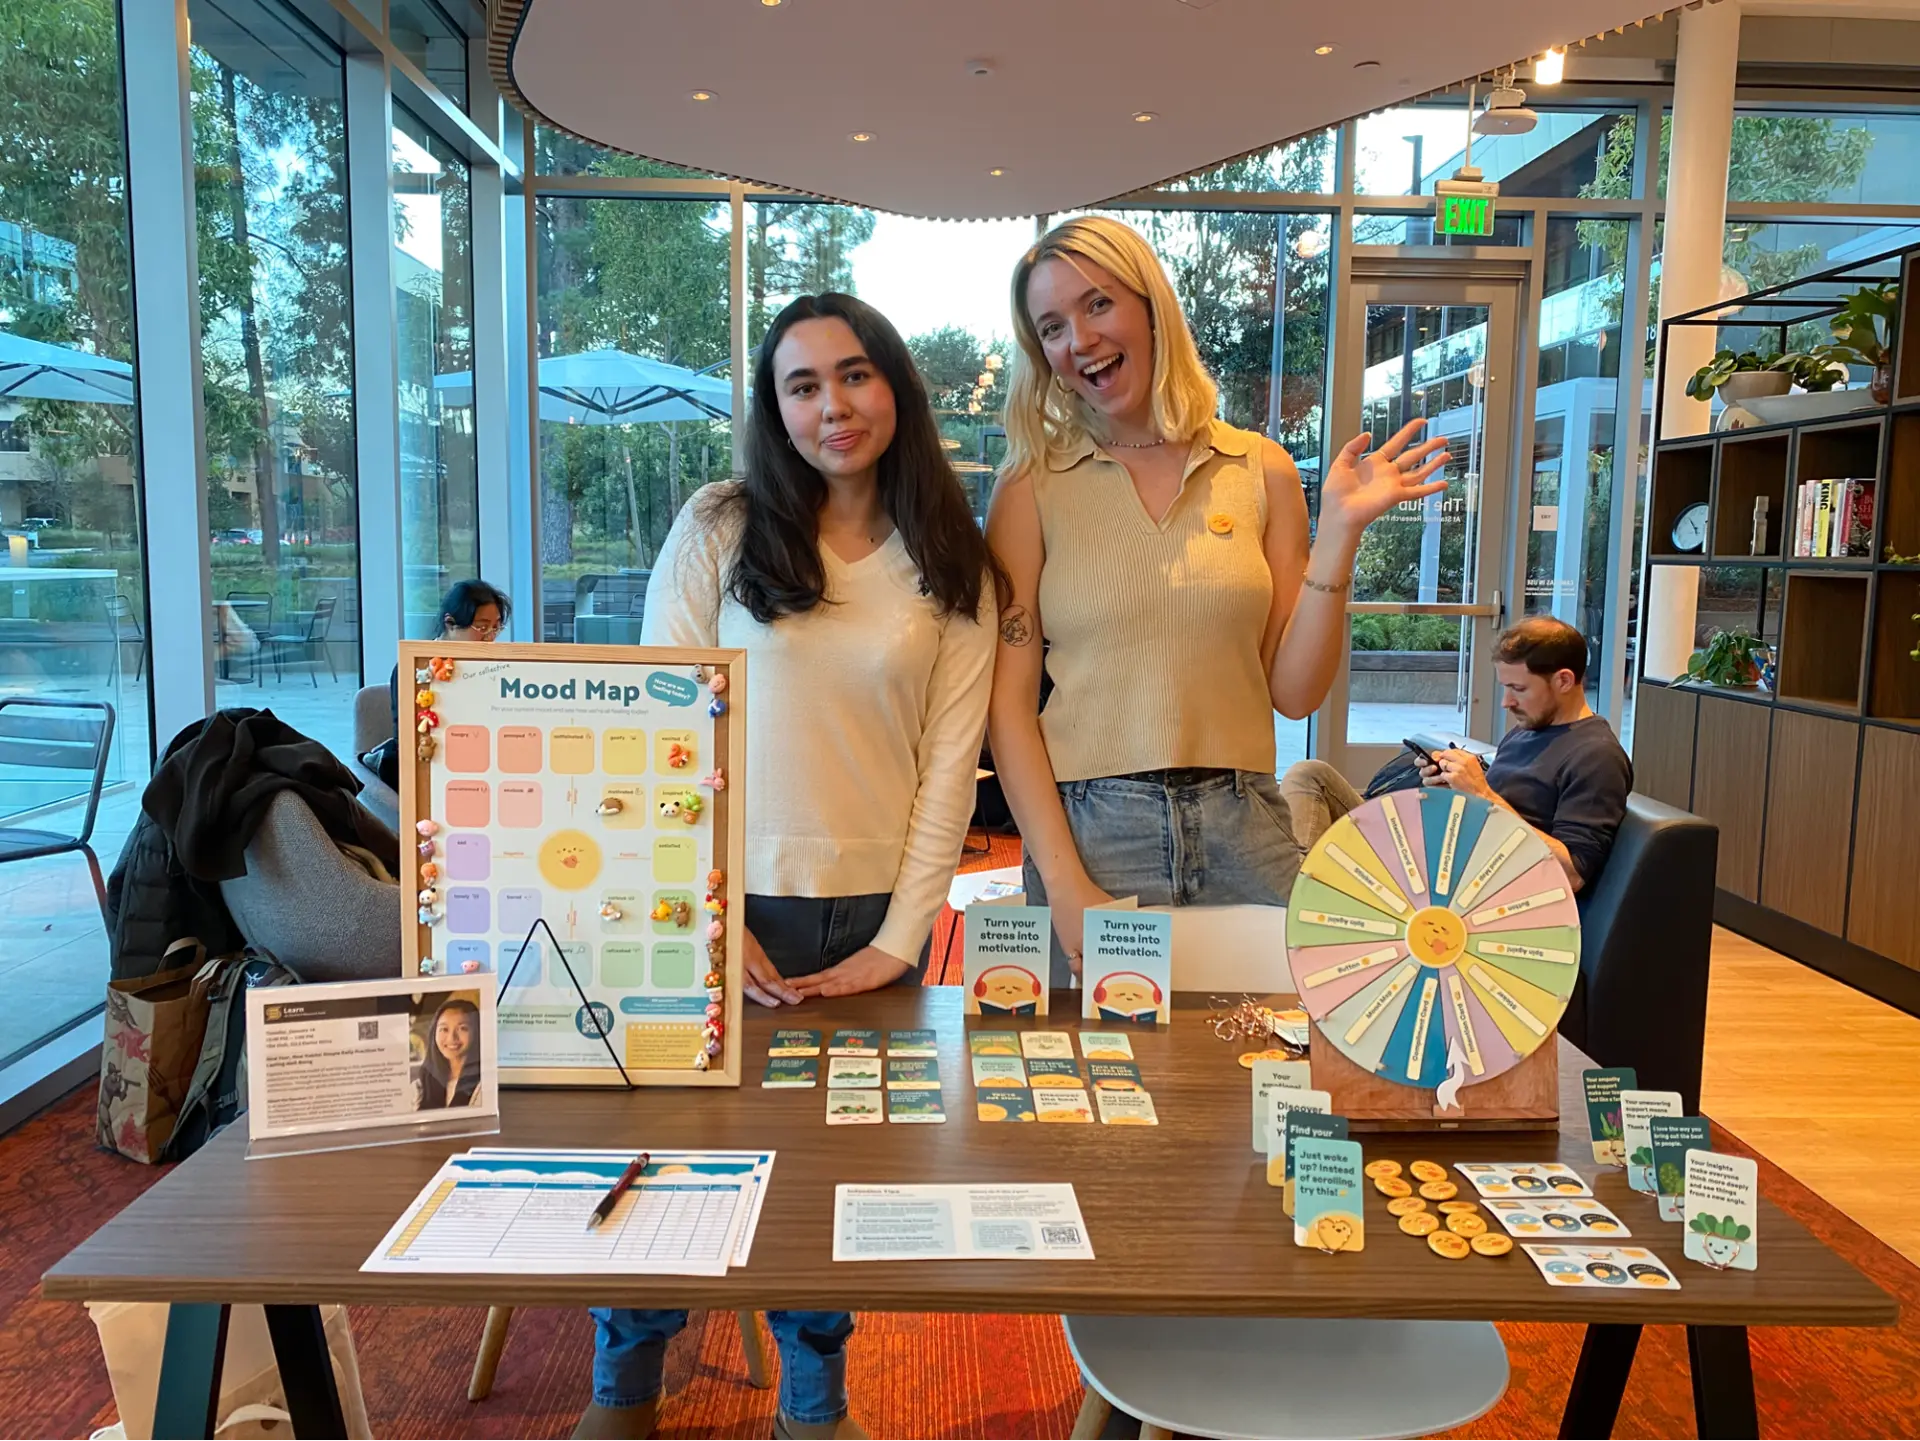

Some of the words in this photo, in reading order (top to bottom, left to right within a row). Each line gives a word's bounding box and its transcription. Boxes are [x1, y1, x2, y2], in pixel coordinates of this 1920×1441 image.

[1444, 197, 1489, 235] EXIT
[1820, 482, 1831, 511] KING
[462, 671, 477, 680] Our
[478, 663, 512, 677] collective
[654, 677, 667, 686] How
[500, 677, 576, 700] Mood
[585, 679, 640, 707] Map
[1446, 812, 1460, 855] Compliment
[1390, 817, 1405, 849] Intention
[1401, 848, 1412, 866] Card
[1442, 855, 1451, 873] Card
[1490, 853, 1505, 870] Mood
[1354, 867, 1375, 887] Sticker
[1479, 868, 1492, 881] Map
[1507, 900, 1531, 911] Button
[983, 917, 1009, 928] Turn
[1011, 920, 1037, 930] your
[1103, 919, 1130, 930] Turn
[1132, 923, 1158, 933] your
[1350, 920, 1365, 928] Spin
[980, 931, 1015, 940] stress
[1017, 931, 1040, 941] into
[1100, 933, 1136, 943] stress
[1138, 933, 1160, 945] into
[978, 943, 1041, 954] motivation.
[1098, 945, 1162, 958] motivation.
[1529, 949, 1544, 957] Spin
[1337, 962, 1361, 973] Button
[1365, 1002, 1381, 1019] Mood
[1380, 990, 1392, 1004] Map
[1496, 991, 1518, 1011] Sticker
[1457, 1003, 1466, 1021] Card
[1412, 1018, 1425, 1061] Compliment
[1420, 1000, 1429, 1018] Card
[1463, 1021, 1475, 1053] Intention
[1261, 1082, 1302, 1090] emotional
[1277, 1101, 1324, 1115] Discover
[1290, 1125, 1310, 1135] Find
[1311, 1128, 1333, 1138] your
[1654, 1133, 1669, 1141] bring
[1300, 1151, 1322, 1160] Just
[1323, 1154, 1349, 1162] woke
[1300, 1162, 1318, 1174] up?
[1690, 1158, 1705, 1166] Your
[1706, 1161, 1733, 1171] insights
[1300, 1174, 1310, 1182] of
[1312, 1176, 1357, 1188] scrolling,
[1690, 1167, 1708, 1175] make
[1708, 1171, 1739, 1181] everyone
[1690, 1174, 1706, 1182] think
[1707, 1178, 1726, 1186] more
[1726, 1181, 1749, 1192] deeply
[1300, 1186, 1315, 1196] try
[1316, 1187, 1338, 1197] this!
[1690, 1189, 1705, 1197] from
[1726, 1197, 1747, 1205] angle.
[1716, 1187, 1737, 1196] things
